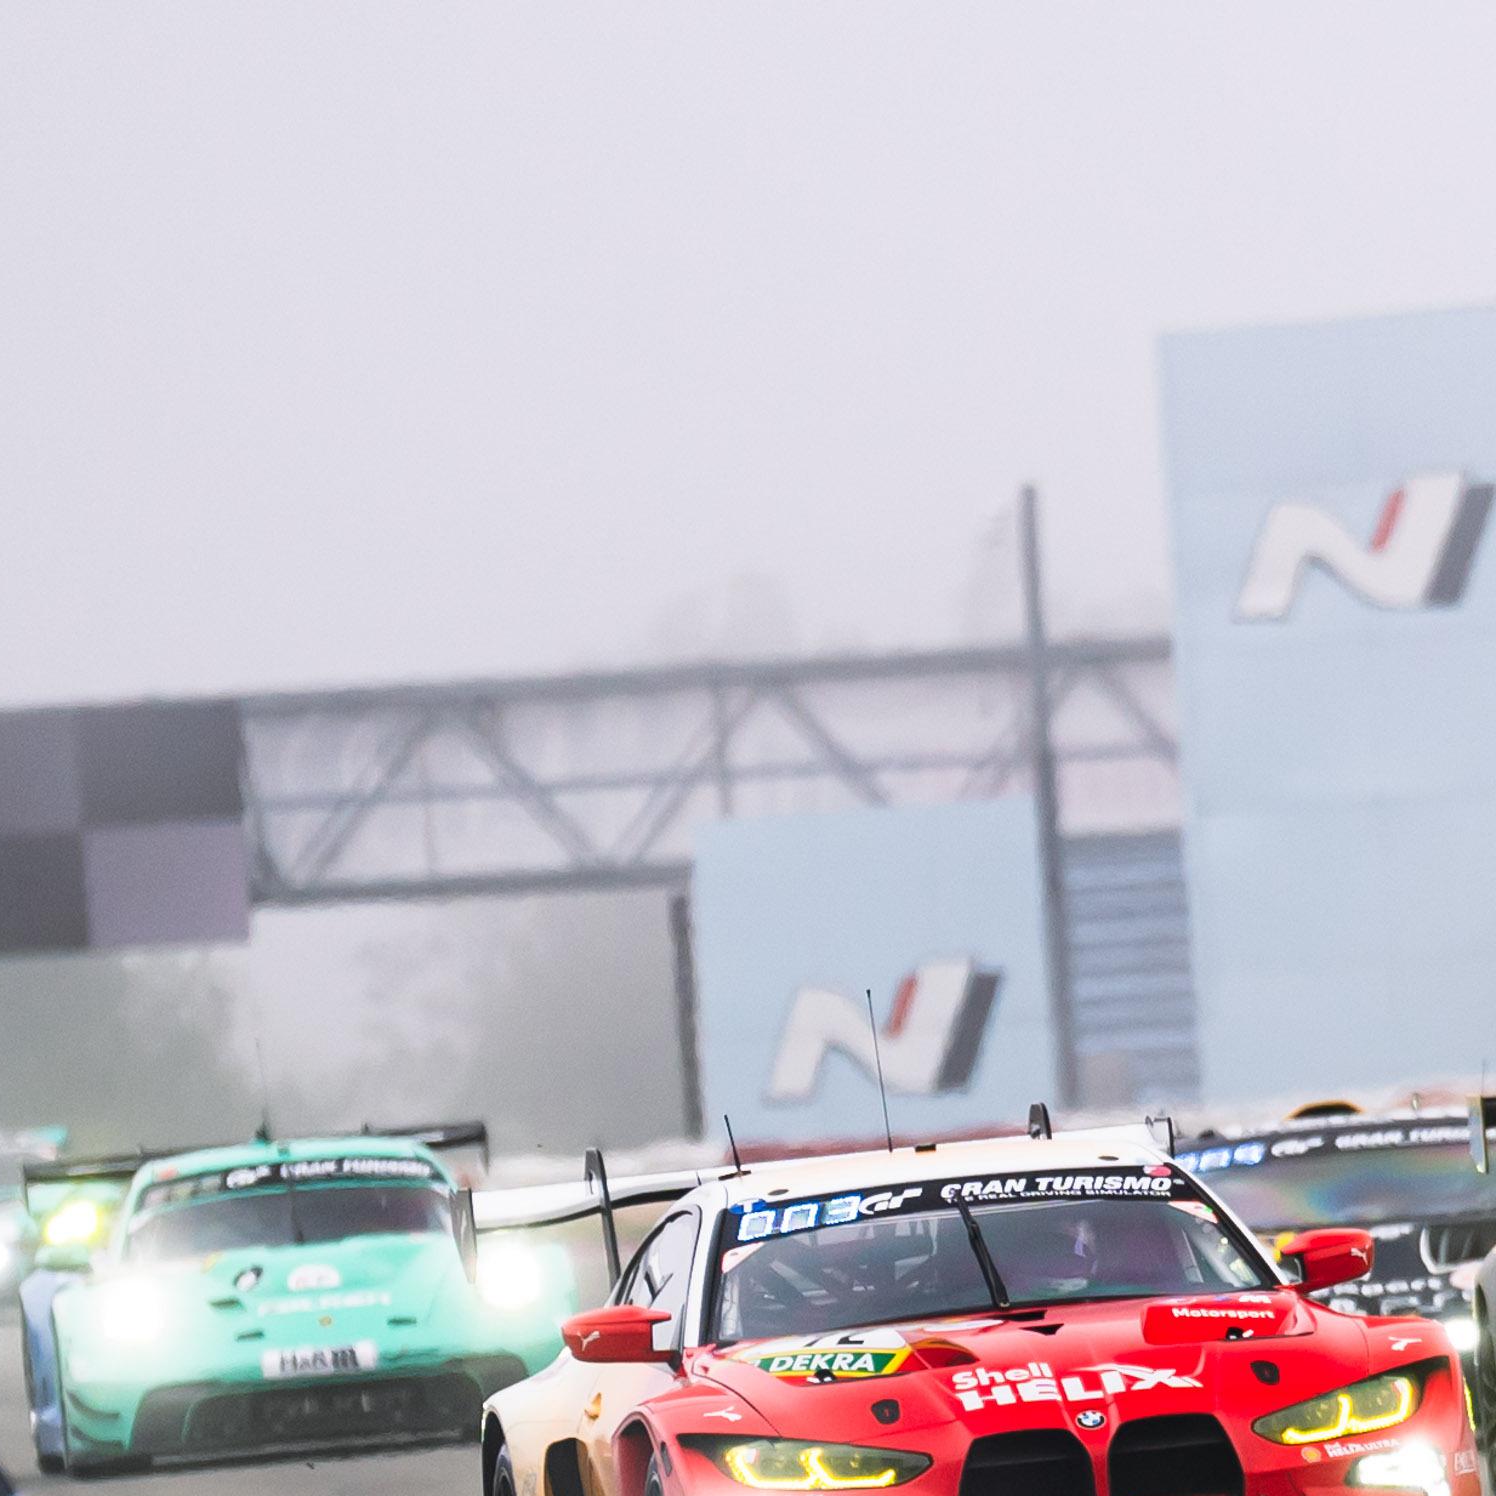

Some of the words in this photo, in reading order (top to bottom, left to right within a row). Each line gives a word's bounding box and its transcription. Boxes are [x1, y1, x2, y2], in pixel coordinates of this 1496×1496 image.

[940, 1178, 1027, 1199] GRAN
[1035, 1175, 1171, 1191] TURISMO
[1171, 1307, 1275, 1320] Motorsport
[769, 1353, 876, 1373] DEKRA
[952, 1362, 1054, 1391] Shell
[956, 1364, 1204, 1413] HELIX
